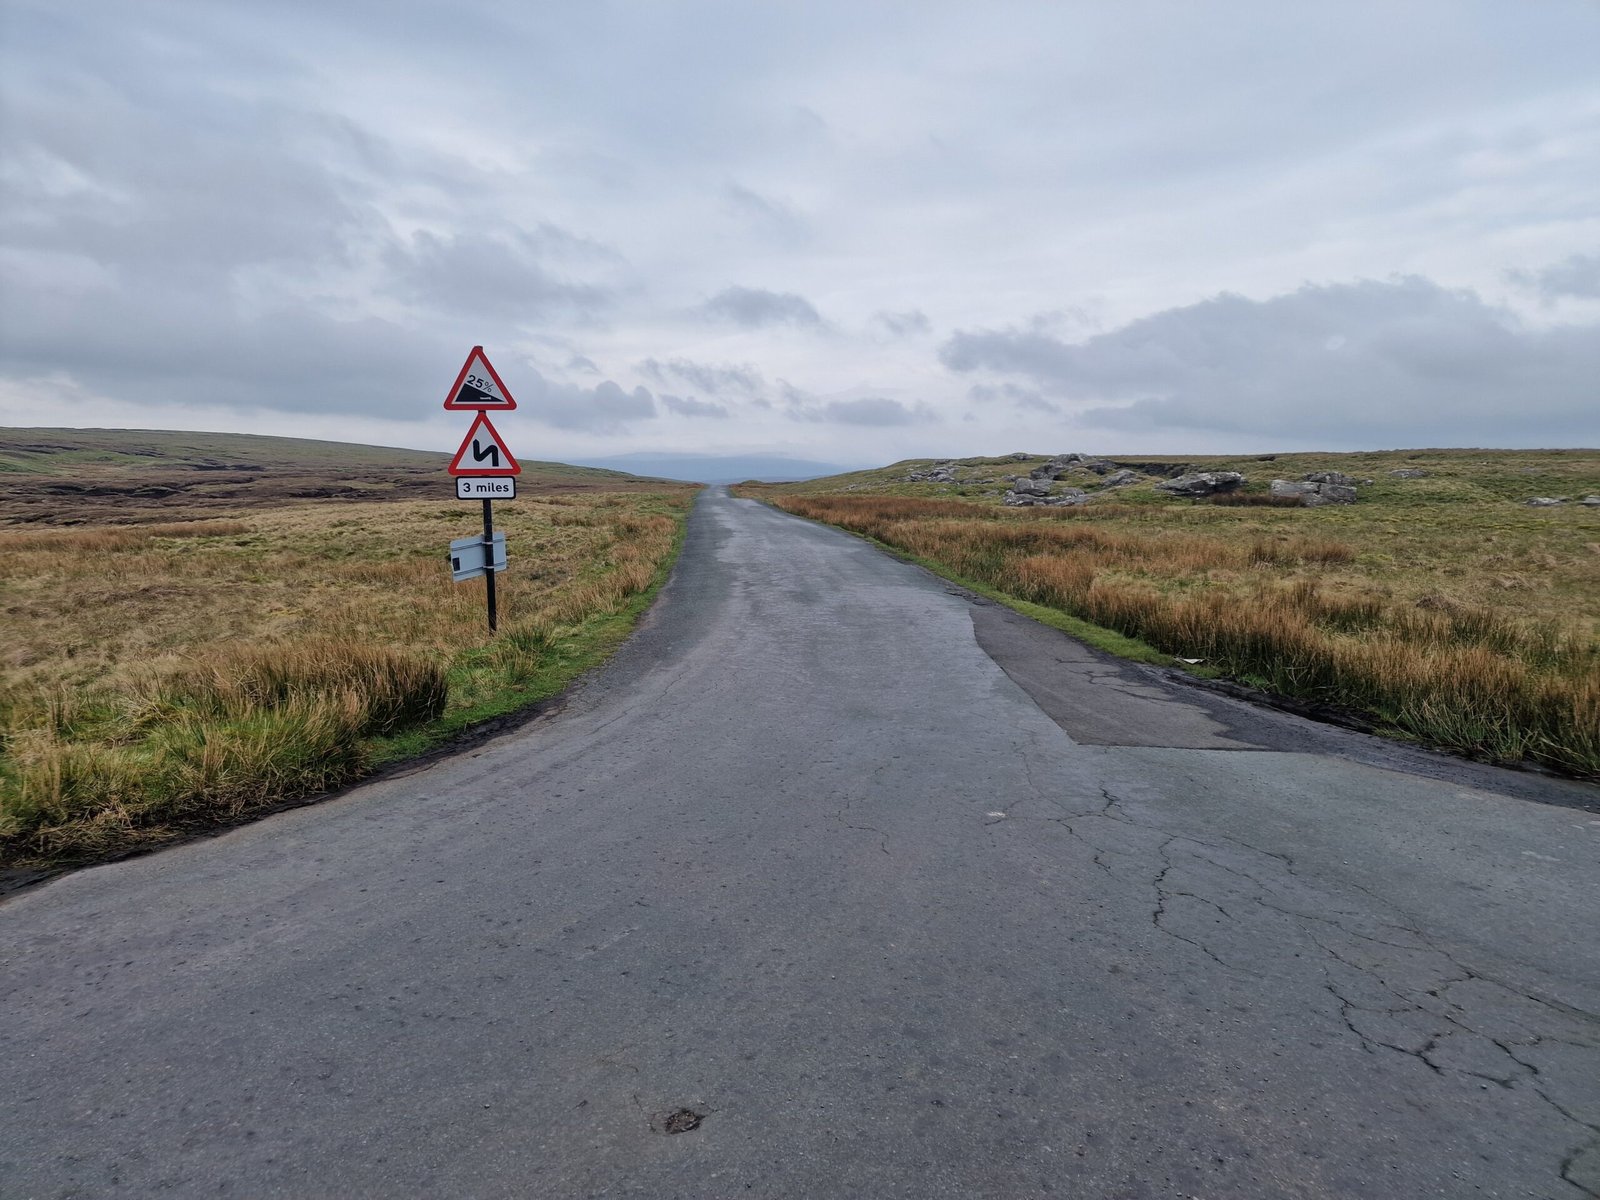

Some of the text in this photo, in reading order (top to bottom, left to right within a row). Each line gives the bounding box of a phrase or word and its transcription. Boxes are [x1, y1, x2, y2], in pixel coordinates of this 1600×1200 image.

[467, 375, 493, 392] 25%
[463, 482, 509, 492] 3 miles
